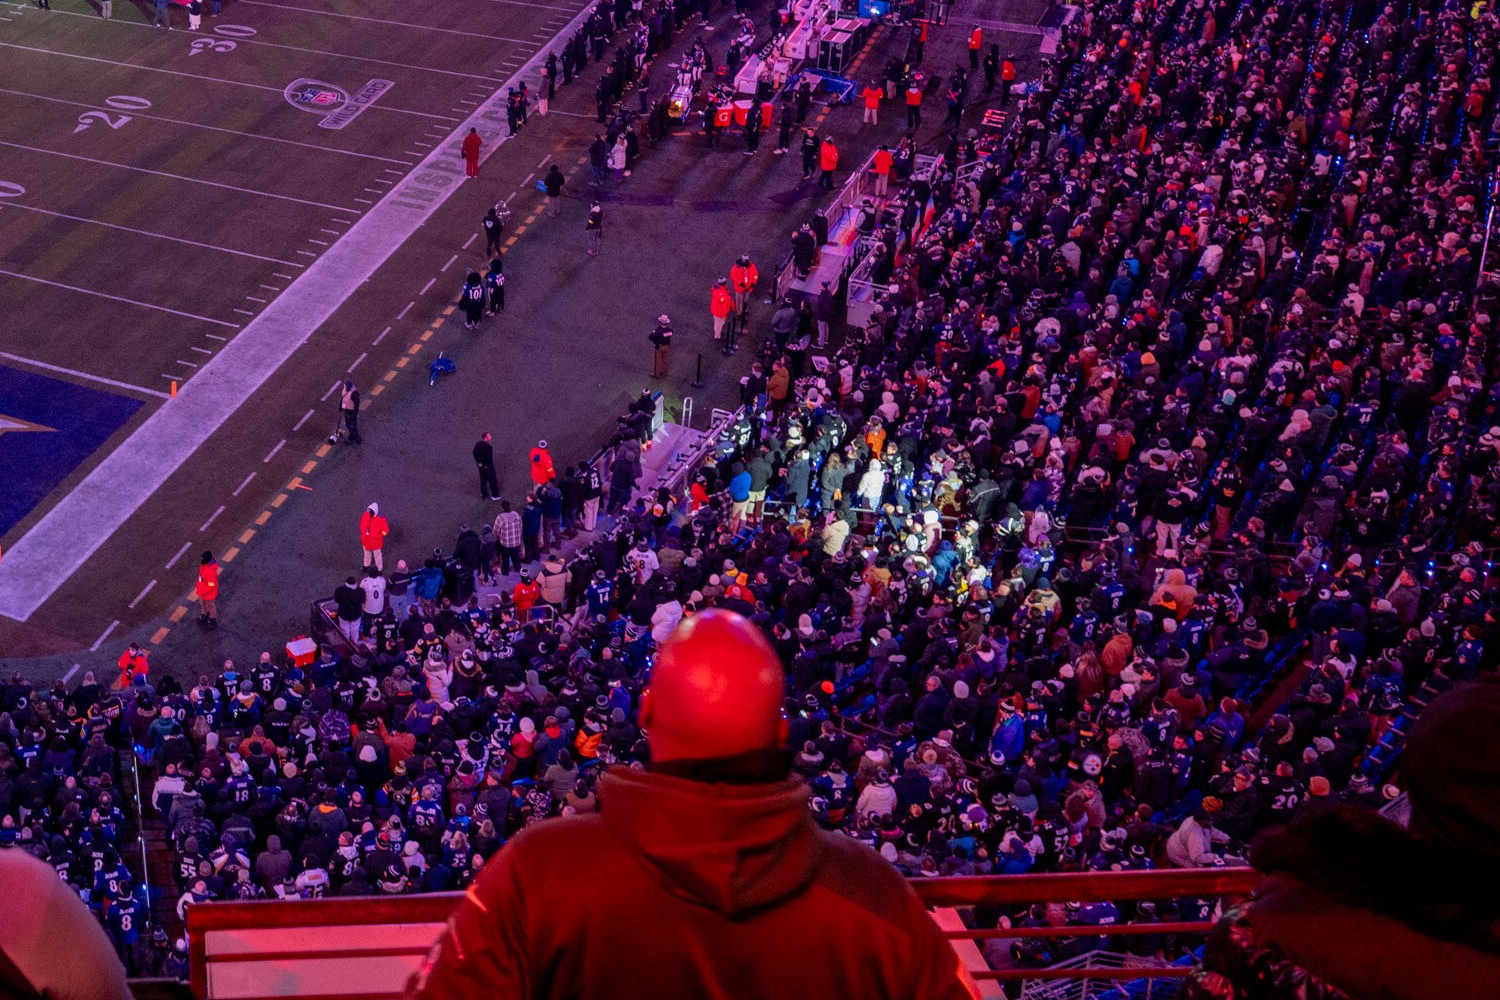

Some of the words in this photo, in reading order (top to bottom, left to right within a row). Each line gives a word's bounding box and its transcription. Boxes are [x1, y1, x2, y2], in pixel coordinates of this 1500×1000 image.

[79, 95, 153, 130] 20
[590, 477, 600, 490] 12
[373, 590, 380, 600] 0
[263, 678, 271, 692] 8
[235, 789, 249, 802] 18
[181, 864, 196, 878] 55
[109, 880, 118, 893] 8
[121, 914, 132, 931] 8
